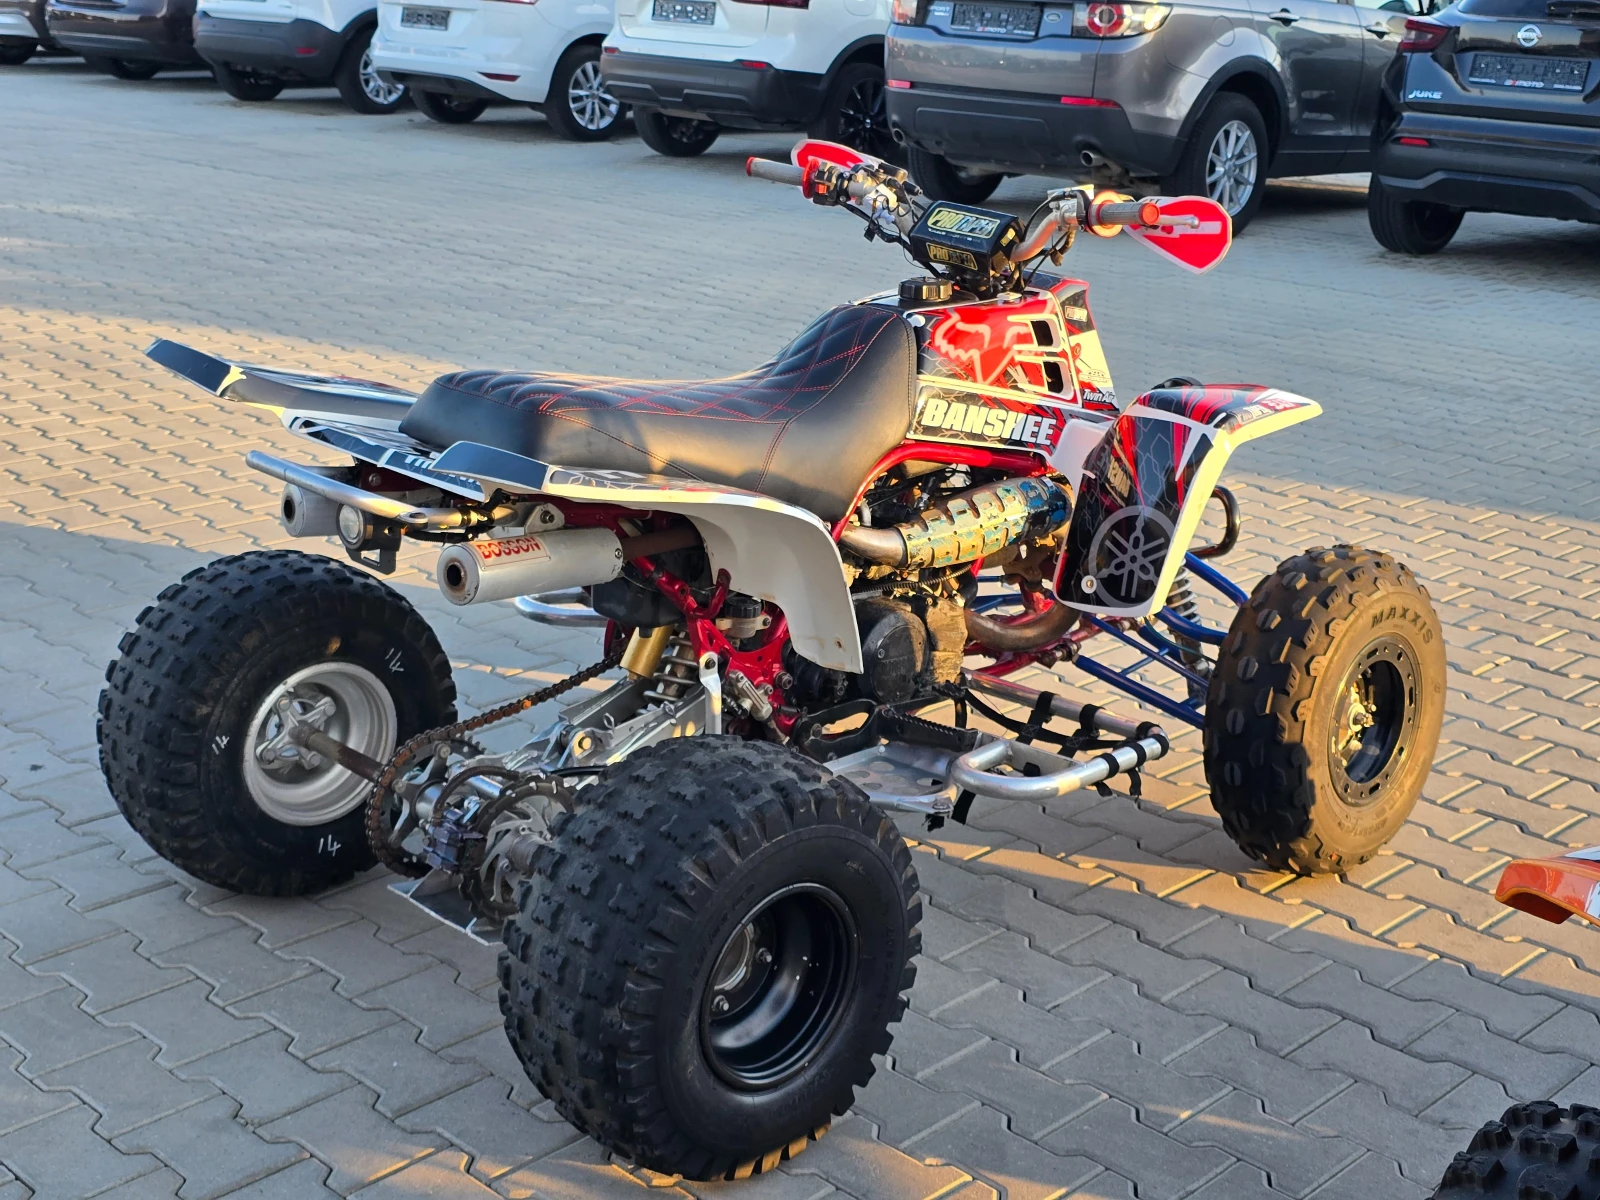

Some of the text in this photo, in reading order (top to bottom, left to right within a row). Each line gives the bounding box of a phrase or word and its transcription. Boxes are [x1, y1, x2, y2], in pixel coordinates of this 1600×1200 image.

[1408, 90, 1443, 100] JUKE
[1083, 388, 1116, 403] Twin Air
[920, 397, 1057, 446] BANSHEE
[476, 535, 541, 560] BOSSON
[1370, 604, 1434, 645] MAXXIS
[384, 647, 405, 673] 14
[211, 735, 230, 755] 14
[318, 833, 342, 858] 14
